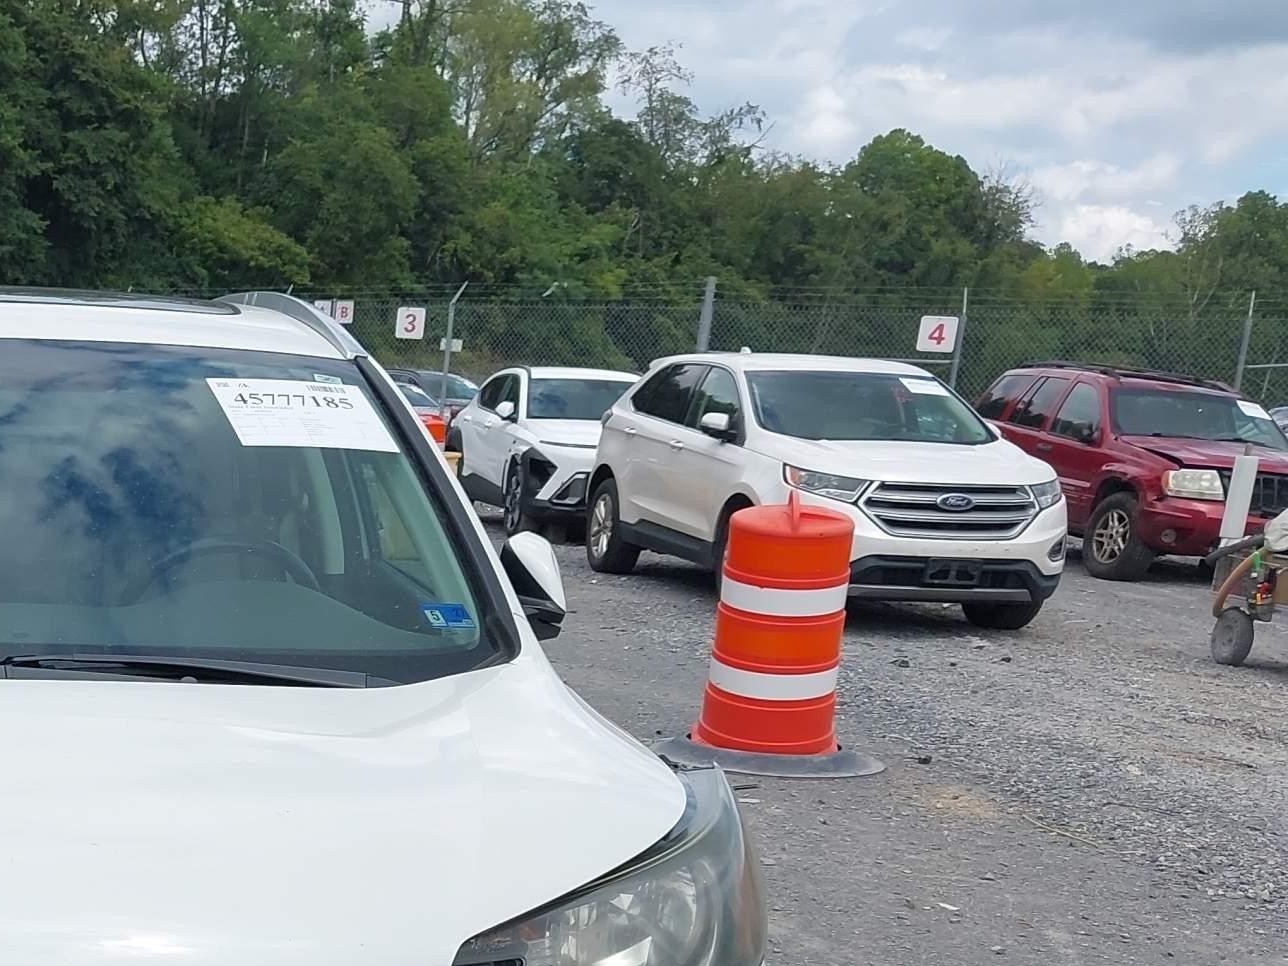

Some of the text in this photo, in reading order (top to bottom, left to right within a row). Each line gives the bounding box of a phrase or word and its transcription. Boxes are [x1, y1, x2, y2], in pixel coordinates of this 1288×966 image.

[341, 306, 348, 318] B
[404, 313, 416, 333] 3
[928, 323, 945, 345] 4
[233, 393, 354, 410] 45777185
[430, 610, 440, 621] 5
